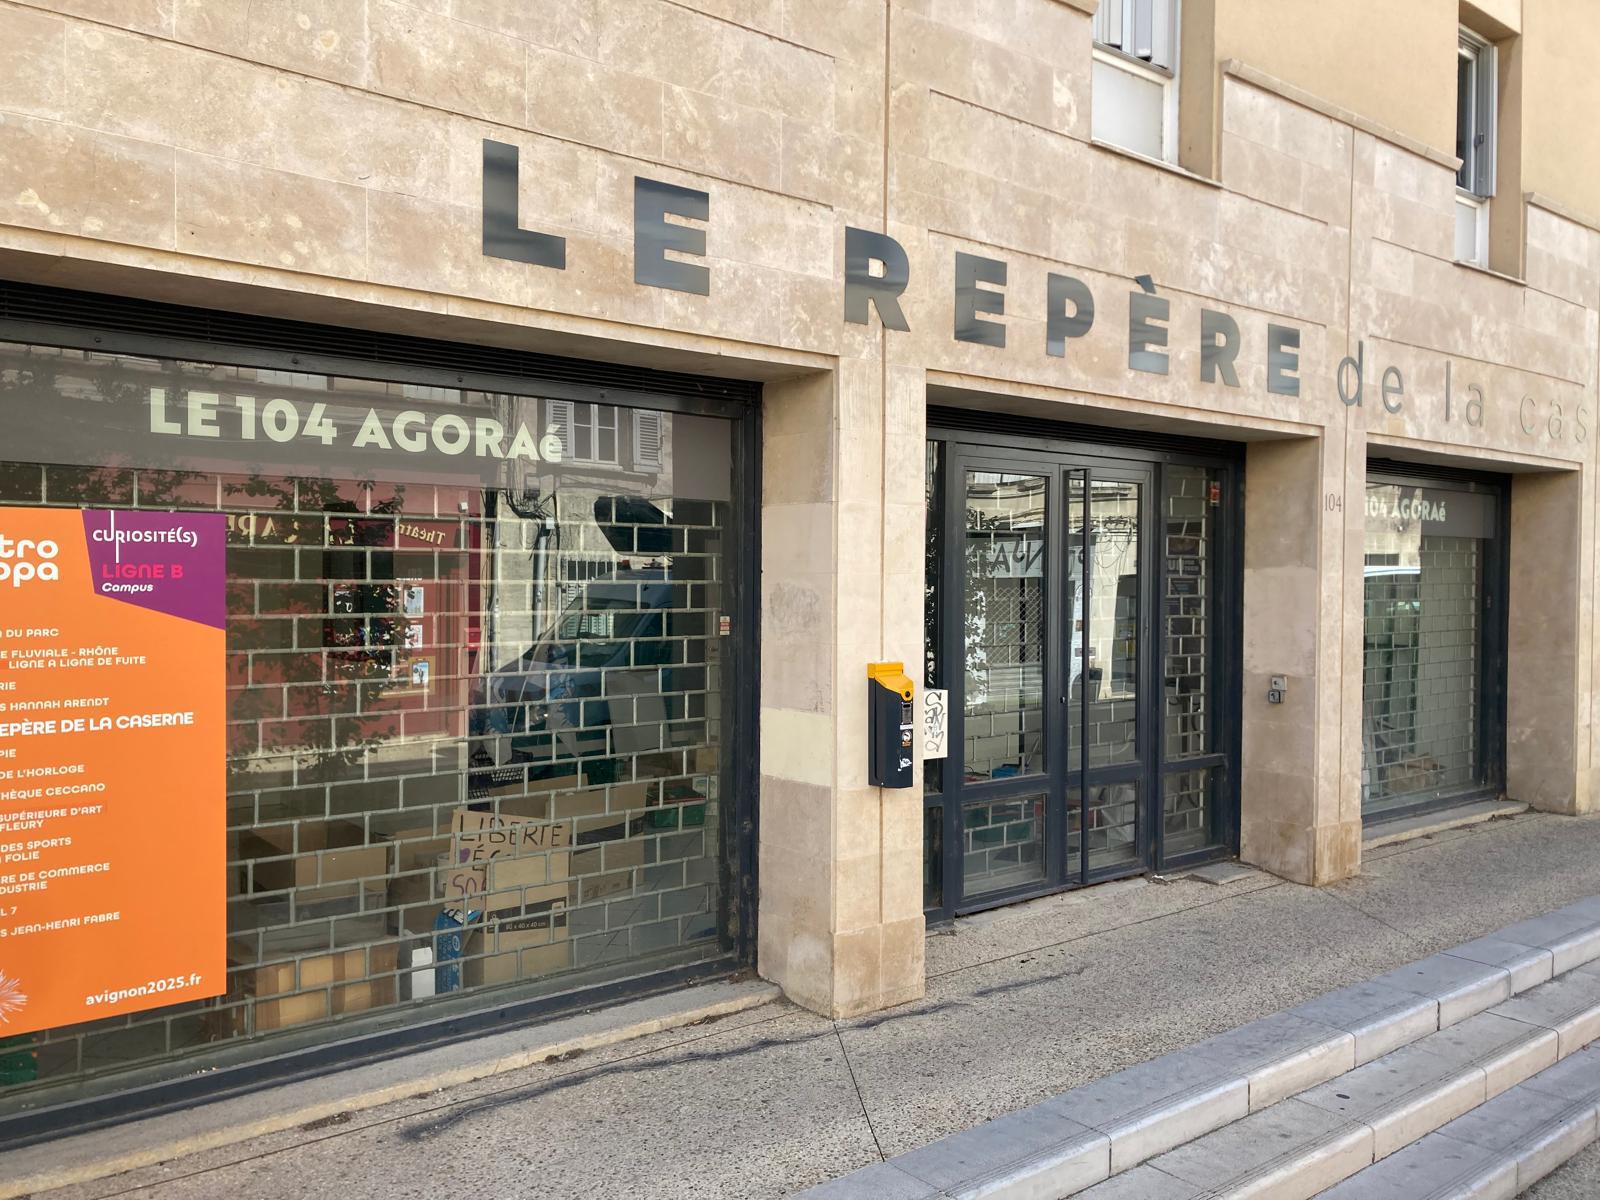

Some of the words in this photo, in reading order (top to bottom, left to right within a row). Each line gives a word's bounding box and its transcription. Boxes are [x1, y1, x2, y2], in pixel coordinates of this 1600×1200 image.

[483, 138, 710, 297] LE
[844, 226, 1300, 398] REPÈRE
[1337, 341, 1404, 414] de
[1442, 360, 1483, 427] la
[1519, 392, 1589, 443] cas
[150, 388, 220, 437] LE
[235, 395, 338, 444] 104
[352, 407, 563, 463] AGORAé
[1324, 493, 1343, 512] 104
[1364, 495, 1388, 518] 104
[1390, 497, 1447, 522] AGORAé
[102, 563, 165, 579] LIGNE
[171, 564, 184, 578] B
[102, 582, 154, 595] Campus
[6, 629, 23, 638] DU
[26, 628, 60, 638] PARC
[11, 648, 69, 659] FLUVIALE
[79, 645, 119, 656] RHÔNE
[8, 660, 45, 669] LIGNE
[48, 660, 56, 668] A
[60, 658, 94, 668] LIGNE
[97, 657, 112, 666] DE
[115, 656, 147, 665] FUITE
[10, 700, 61, 712] HANNAH
[64, 697, 110, 708] ARENDT
[0, 718, 57, 737] EPÈRE
[61, 718, 85, 733] DE
[89, 717, 112, 731] LA
[116, 711, 195, 730] CASERNE
[17, 764, 85, 778] L'HORLOGE
[0, 788, 43, 801] HÈQUE
[45, 783, 106, 796] CECCANO
[70, 805, 103, 816] D'ART
[0, 820, 45, 832] FLEURY
[0, 842, 23, 853] DES
[26, 837, 72, 850] SPORTS
[5, 851, 40, 863] FOLIE
[1, 875, 16, 884] RE
[19, 872, 36, 882] DE
[38, 862, 111, 880] COMMERCE
[0, 881, 48, 895] DUSTRIE
[10, 906, 17, 915] 7
[10, 917, 81, 936] JEAN-HENRI
[83, 911, 121, 925] FABRE
[85, 972, 202, 1006] avignon2025.fr
